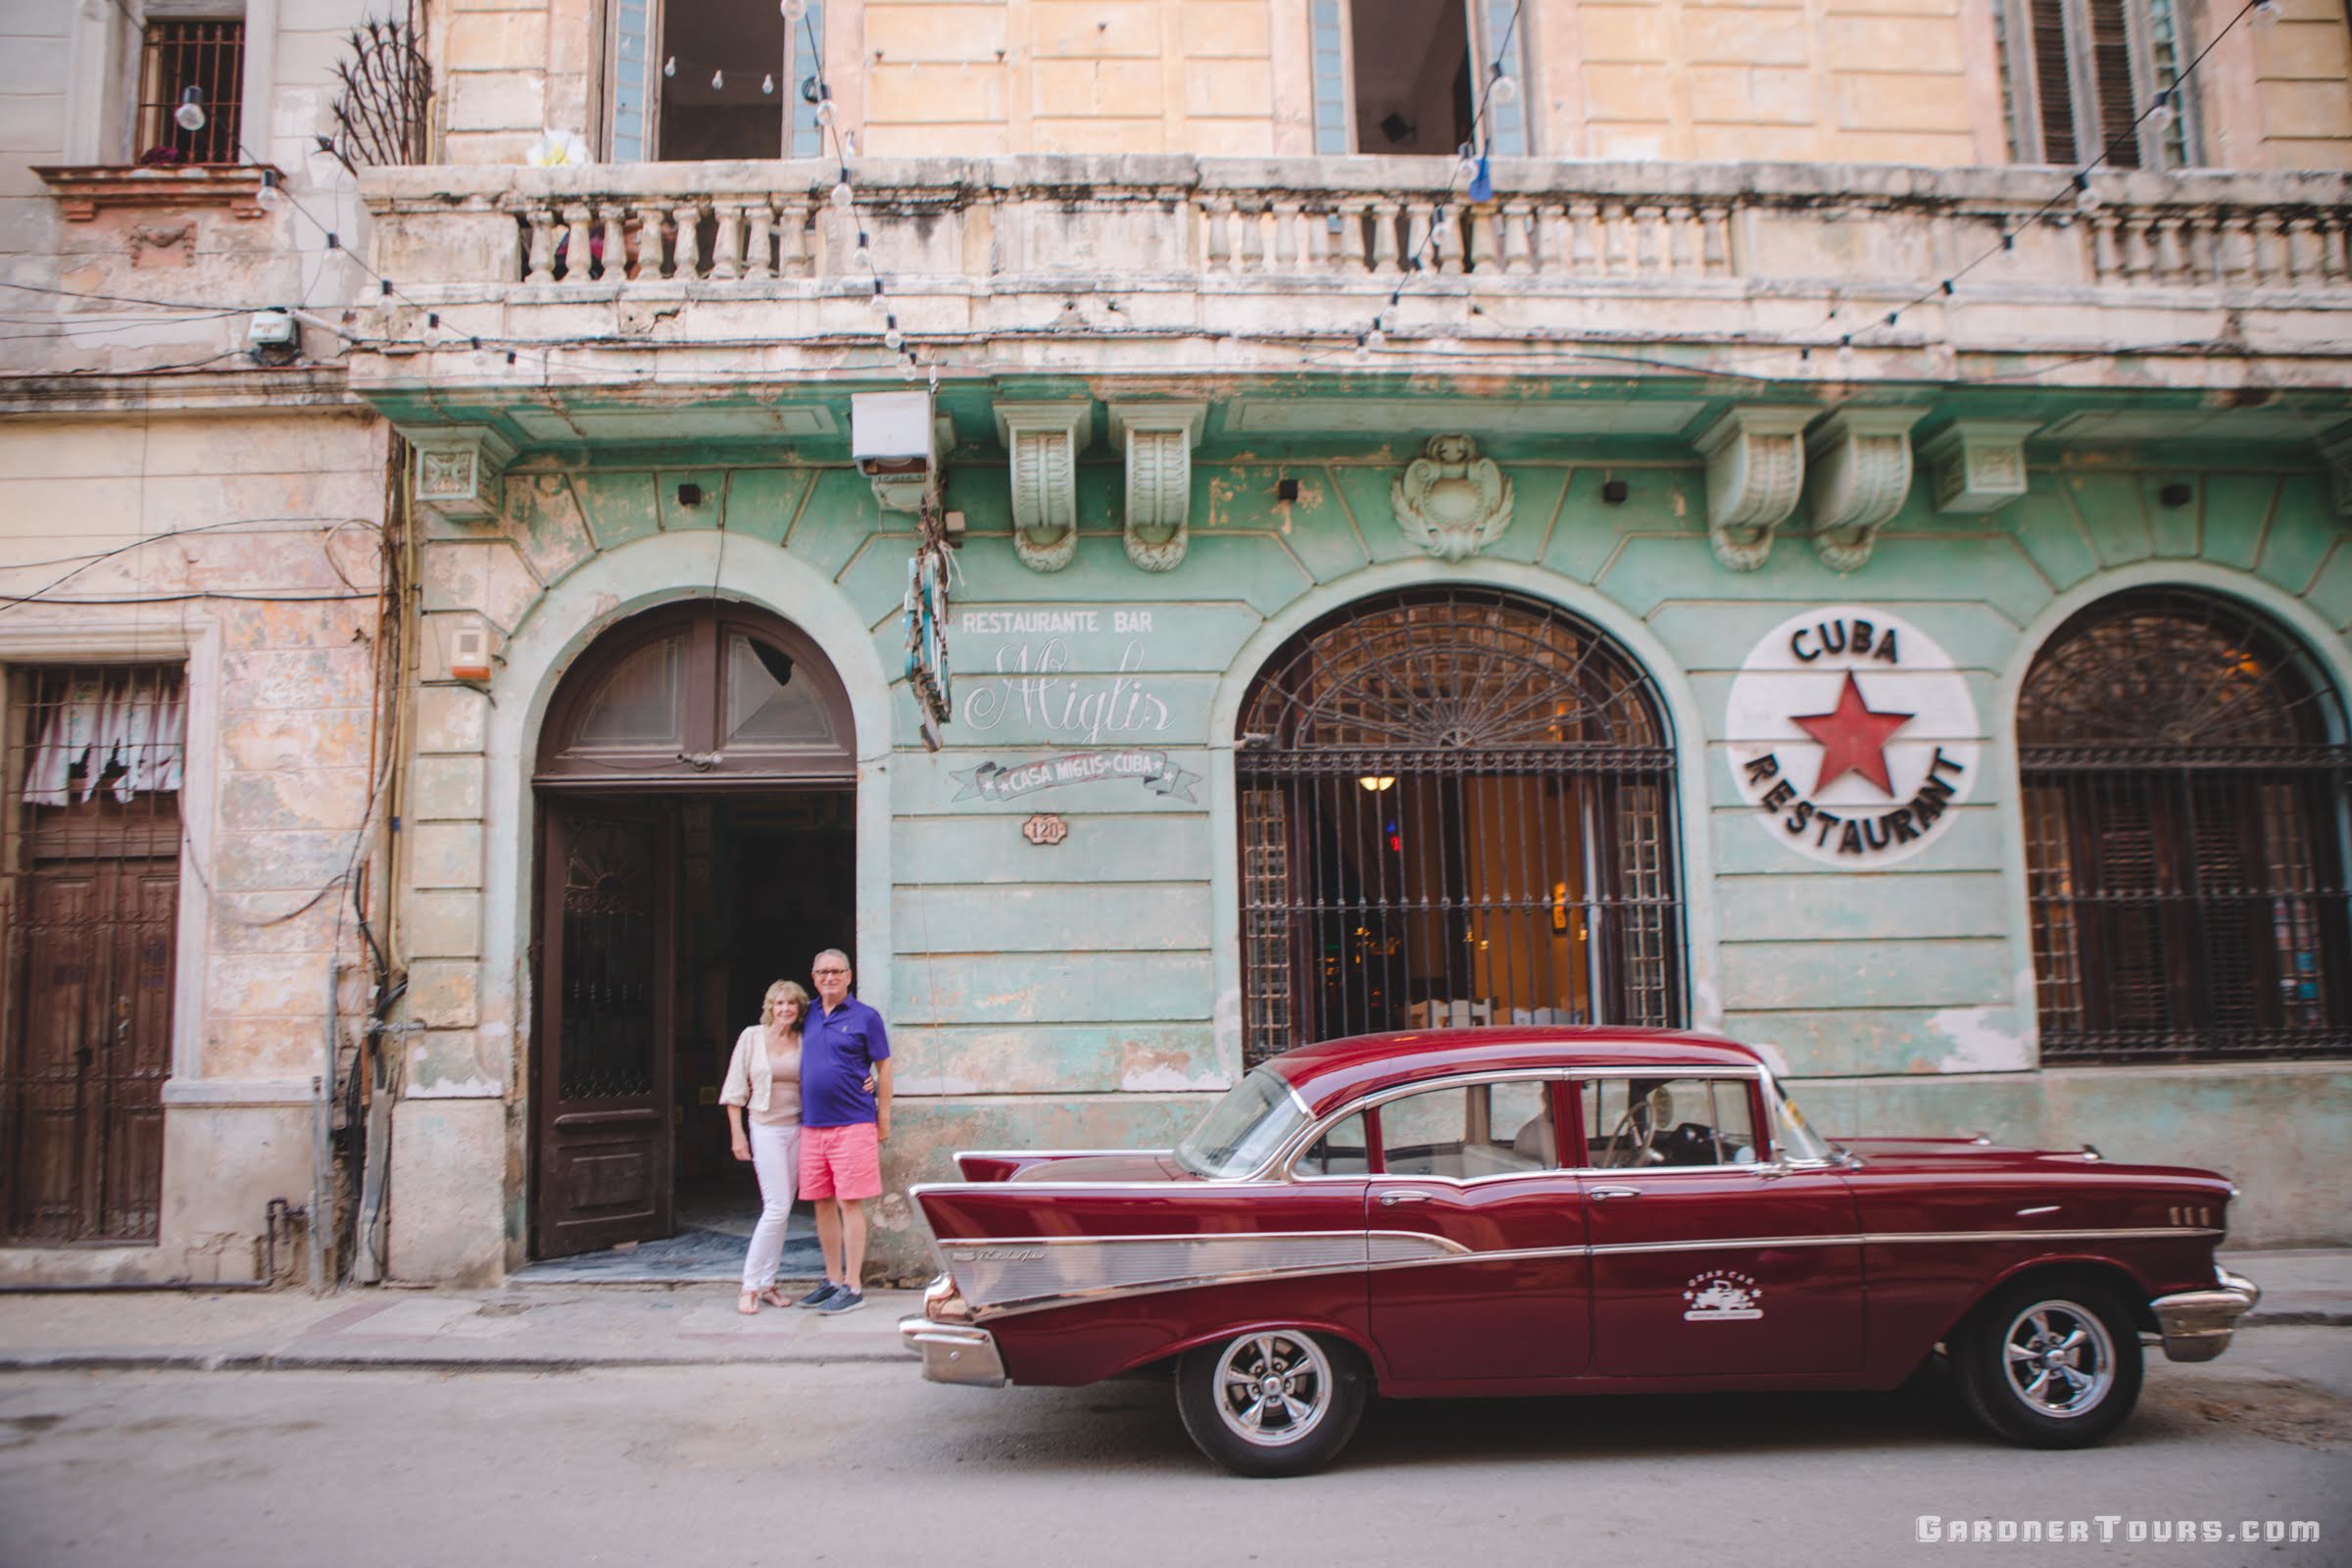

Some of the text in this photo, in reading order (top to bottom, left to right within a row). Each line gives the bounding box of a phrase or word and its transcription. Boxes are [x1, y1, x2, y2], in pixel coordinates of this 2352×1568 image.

[962, 611, 1153, 634] RESTAURANTE BAR
[1790, 619, 1898, 664] CUBA
[963, 638, 1176, 745] Miglis
[1009, 753, 1152, 791] CASA MIGLIS CUBA
[1743, 746, 1965, 854] RESTAURANT
[1033, 822, 1059, 838] 120
